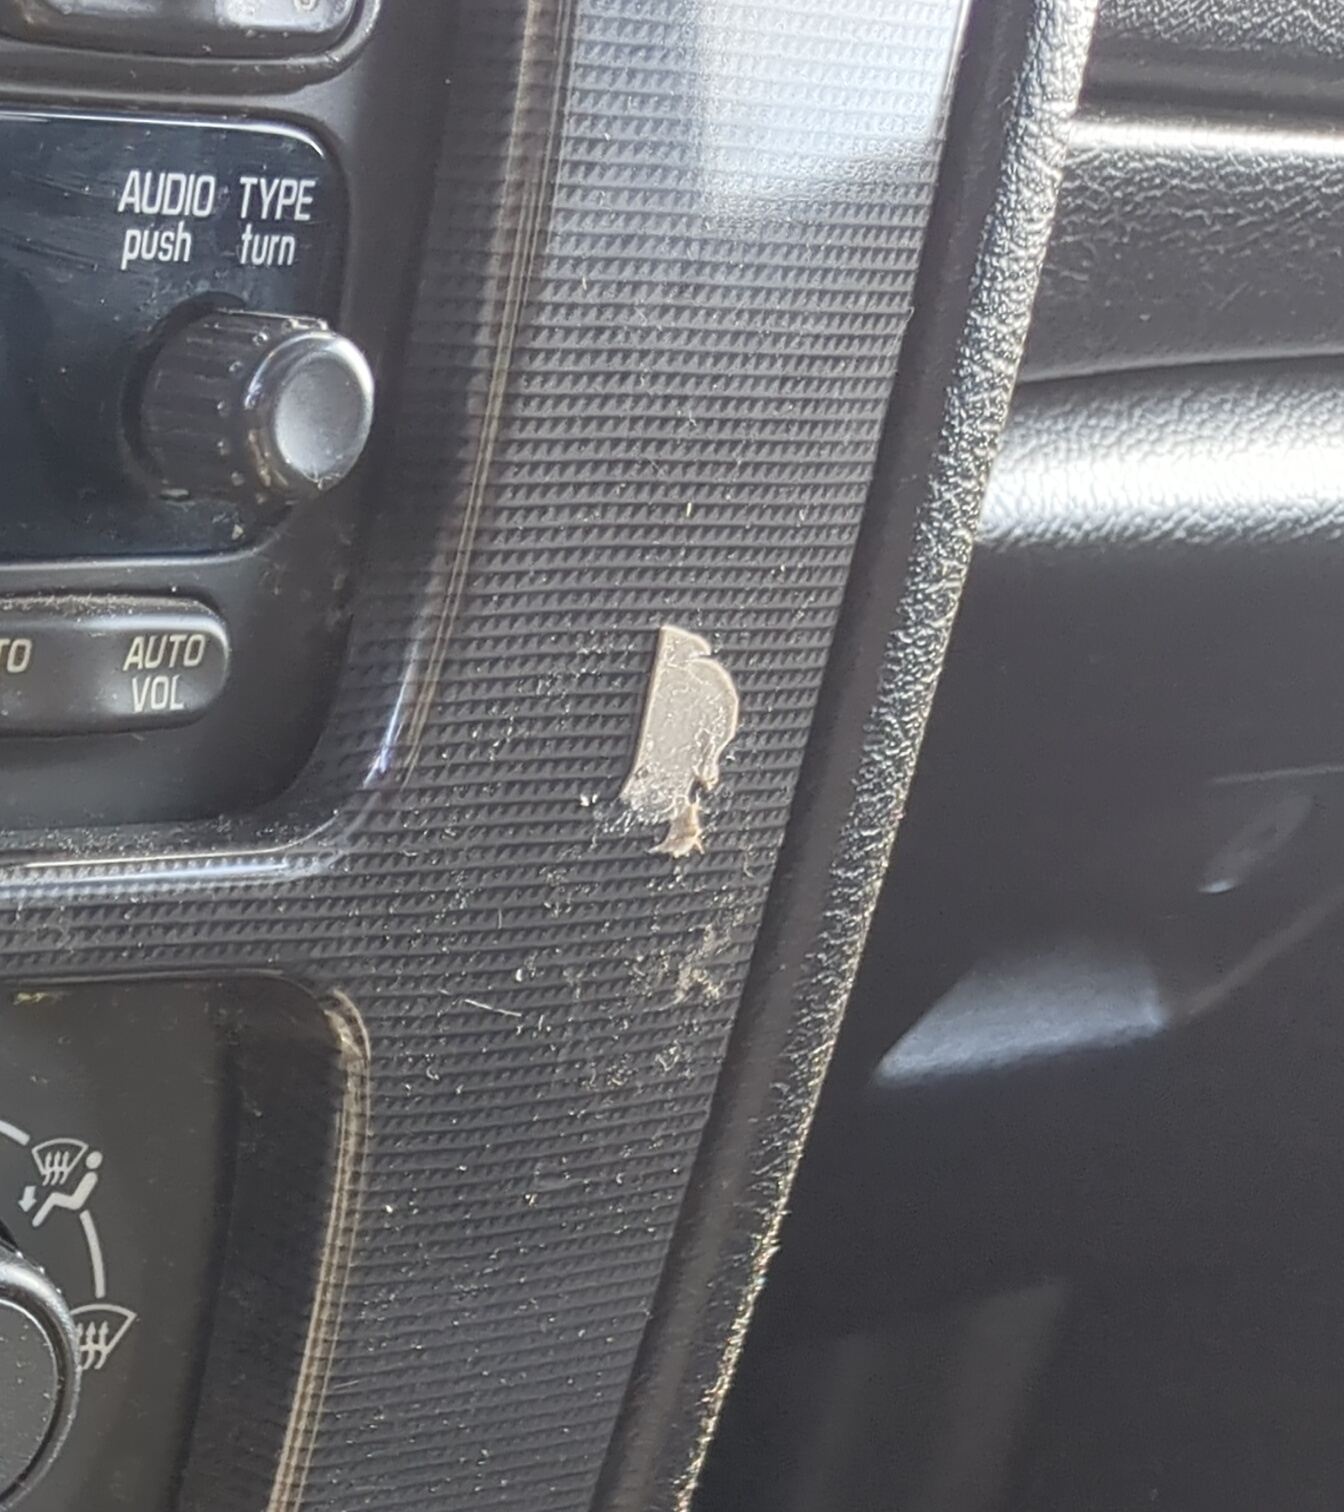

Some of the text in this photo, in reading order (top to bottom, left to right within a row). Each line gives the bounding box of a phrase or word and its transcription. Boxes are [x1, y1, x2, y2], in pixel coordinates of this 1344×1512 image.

[117, 169, 316, 221] AUDIO TYPE
[119, 220, 296, 270] push turn
[122, 633, 207, 671] AUTO
[131, 675, 185, 713] VOL
